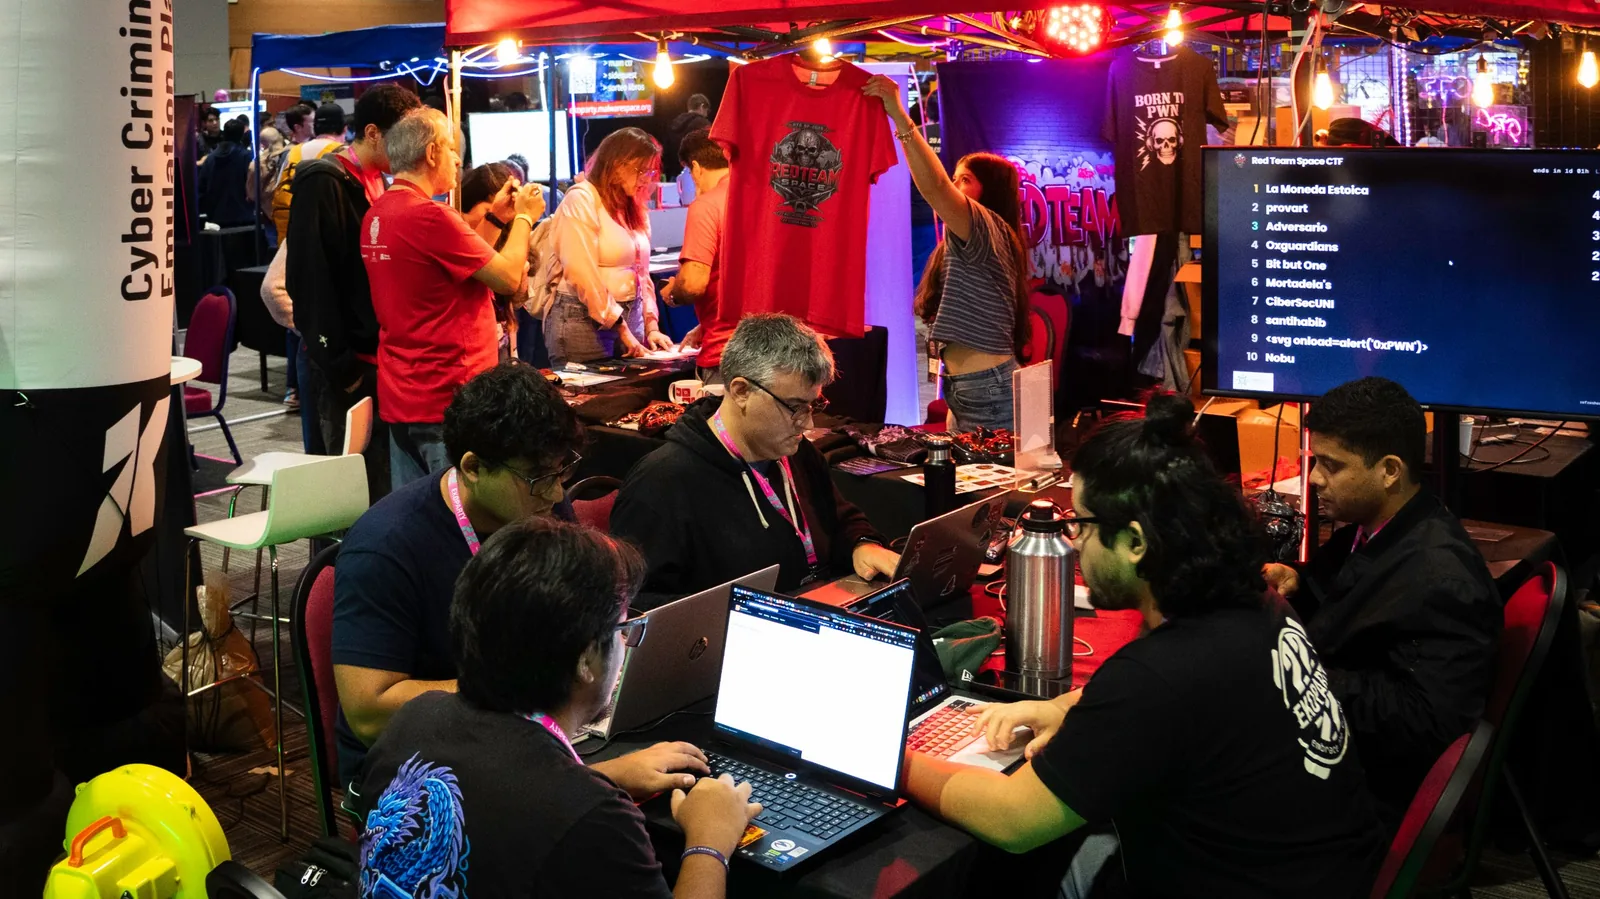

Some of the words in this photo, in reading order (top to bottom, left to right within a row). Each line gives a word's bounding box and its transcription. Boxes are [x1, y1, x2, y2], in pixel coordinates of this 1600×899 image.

[119, 0, 154, 149] Crimin
[1134, 92, 1171, 107] BORN
[1146, 104, 1179, 118] PWN
[1252, 156, 1268, 165] Red
[1270, 157, 1296, 165] Team
[1297, 157, 1325, 167] Space
[1326, 157, 1343, 166] CTF
[771, 163, 841, 186] REDTEAM
[781, 178, 826, 191] SPACE
[1254, 184, 1259, 193] 1
[1266, 184, 1278, 194] La
[1280, 185, 1326, 195] Moneda
[1328, 185, 1369, 196] Estoica
[1252, 203, 1259, 212] 2
[1266, 203, 1308, 215] provart
[121, 165, 159, 301] Cyber
[1252, 221, 1259, 230] 3
[1266, 222, 1328, 233] Adversario
[1251, 240, 1259, 249] 4
[1251, 259, 1259, 268] 5
[1266, 259, 1282, 269] Bit
[1282, 260, 1302, 270] but
[1303, 260, 1327, 271] One
[1251, 277, 1259, 286] 6
[1266, 278, 1332, 290] Mortadela's
[1251, 297, 1259, 305] 7
[1266, 296, 1335, 309] CiberSecUNI
[1251, 315, 1258, 324] 8
[1265, 316, 1327, 328] santihabib
[1251, 334, 1258, 343] 9
[1266, 336, 1292, 347] <svg
[1246, 351, 1258, 361] 10
[1265, 352, 1296, 364] Nobu
